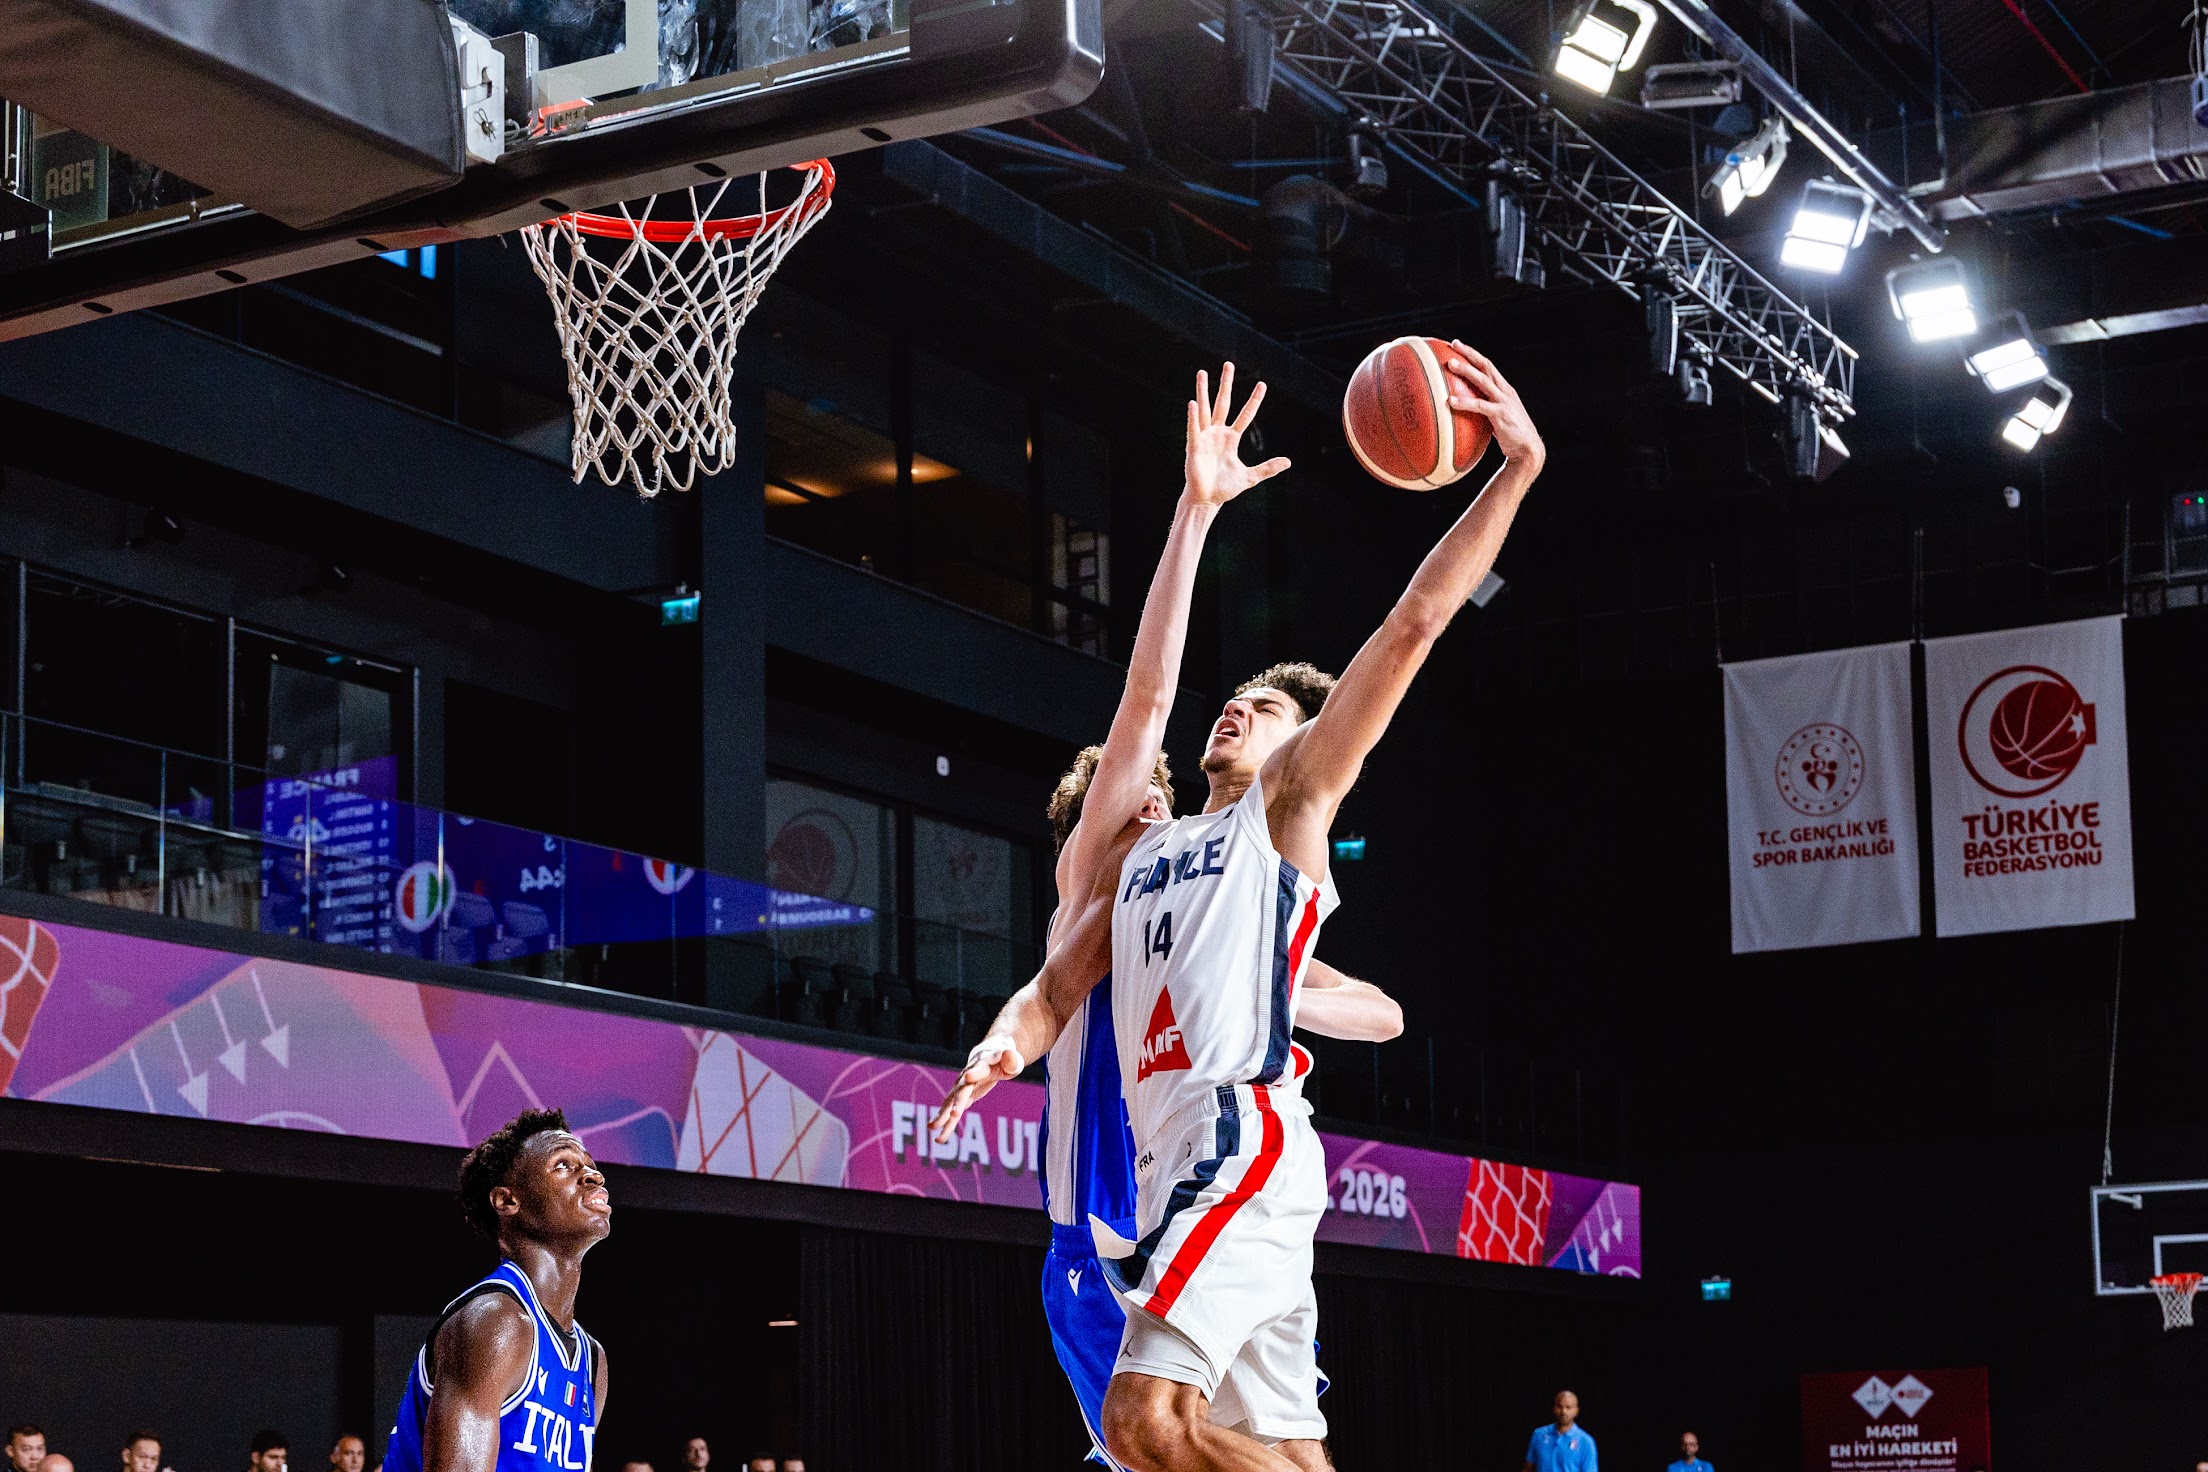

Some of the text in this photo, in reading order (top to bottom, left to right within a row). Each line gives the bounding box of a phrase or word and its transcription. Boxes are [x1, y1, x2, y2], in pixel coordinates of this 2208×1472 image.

[1757, 818, 1888, 846] T.C. GENÇLİK VE
[1962, 799, 2101, 839] TÜRKİYE
[1752, 837, 1895, 869] SPOR BAKANLIĞI
[1963, 829, 2102, 860] BASKETBOL
[1964, 850, 2102, 878] FEDERASYONU
[1144, 911, 1174, 969] 14
[998, 1116, 1039, 1171] U1
[1139, 1151, 1155, 1173] FRA
[1340, 1168, 1407, 1219] 2026
[1829, 1437, 1958, 1458] EN İYİ HAREKETİ
[1865, 1424, 1919, 1440] MAÇIN
